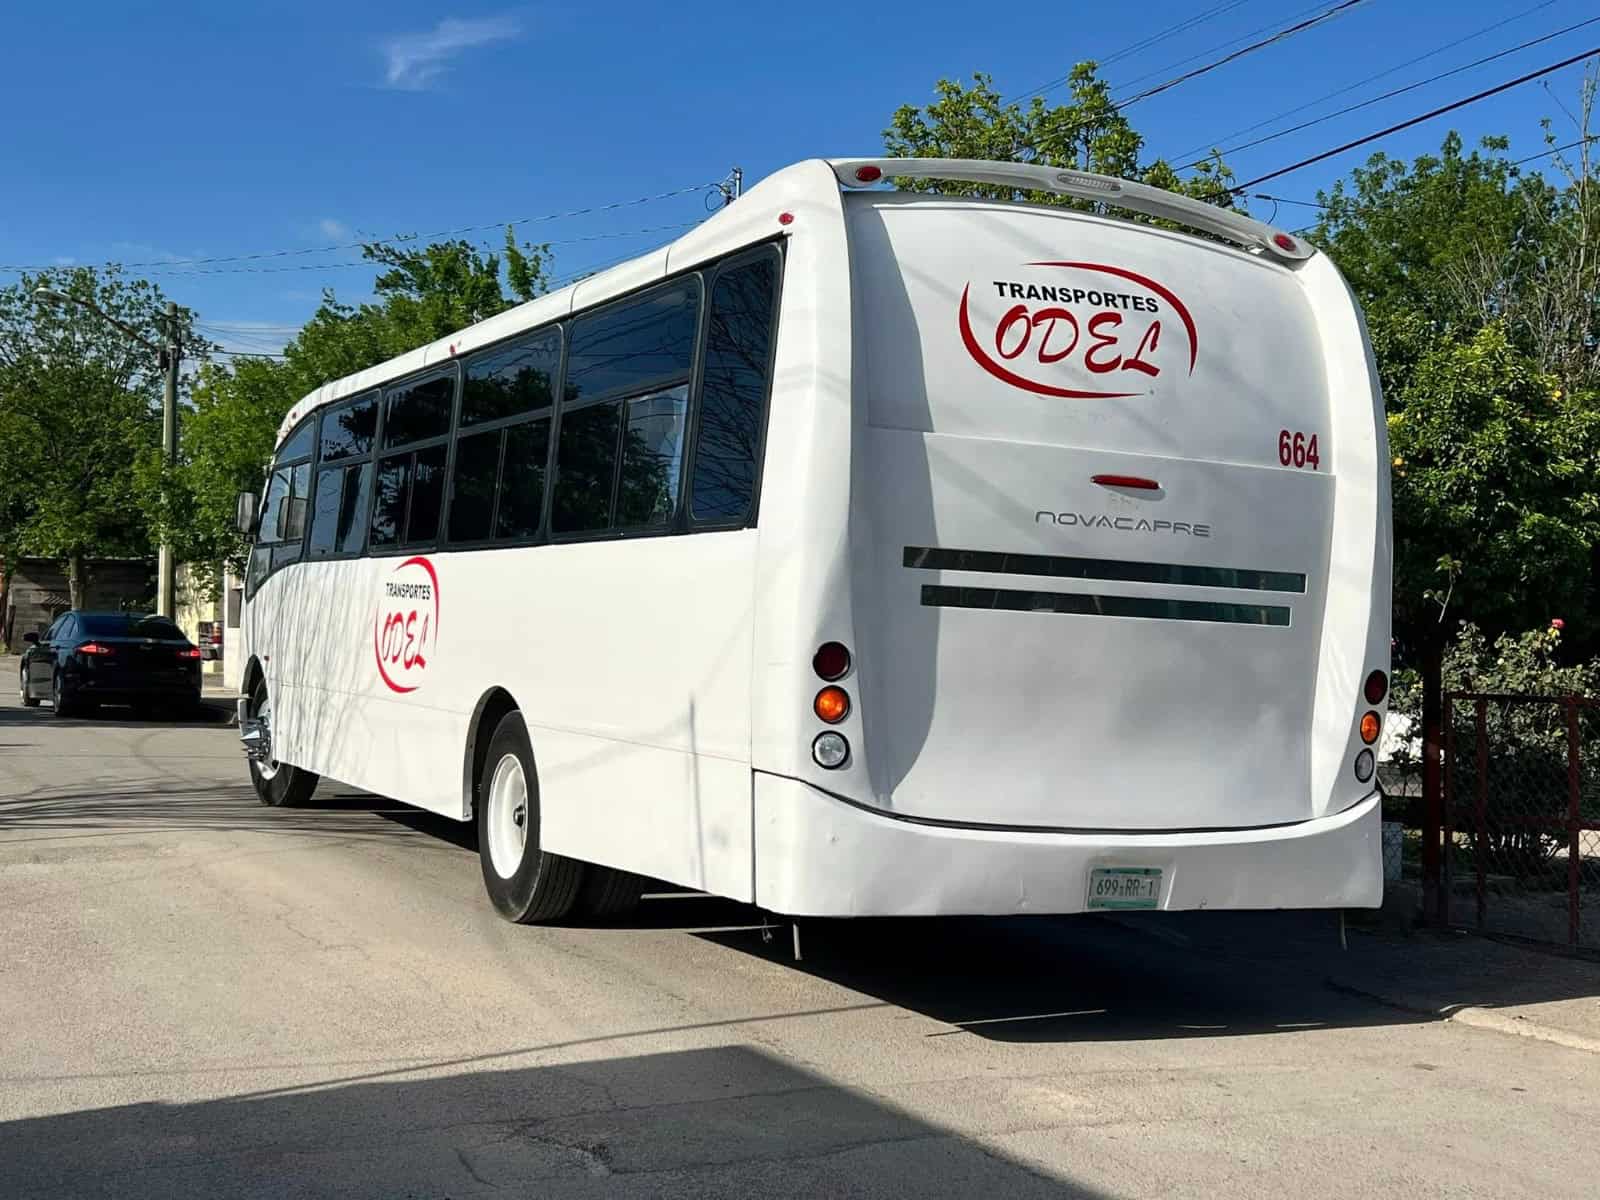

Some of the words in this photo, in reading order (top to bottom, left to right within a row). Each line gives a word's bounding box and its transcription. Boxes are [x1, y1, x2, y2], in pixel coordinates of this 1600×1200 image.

[993, 281, 1159, 313] TRANSPORTES
[995, 304, 1161, 377] ODEL
[1278, 430, 1320, 470] 664
[1035, 511, 1210, 537] NOVACAPRE
[385, 583, 431, 600] TRANSPORTES
[382, 610, 429, 670] ODEL
